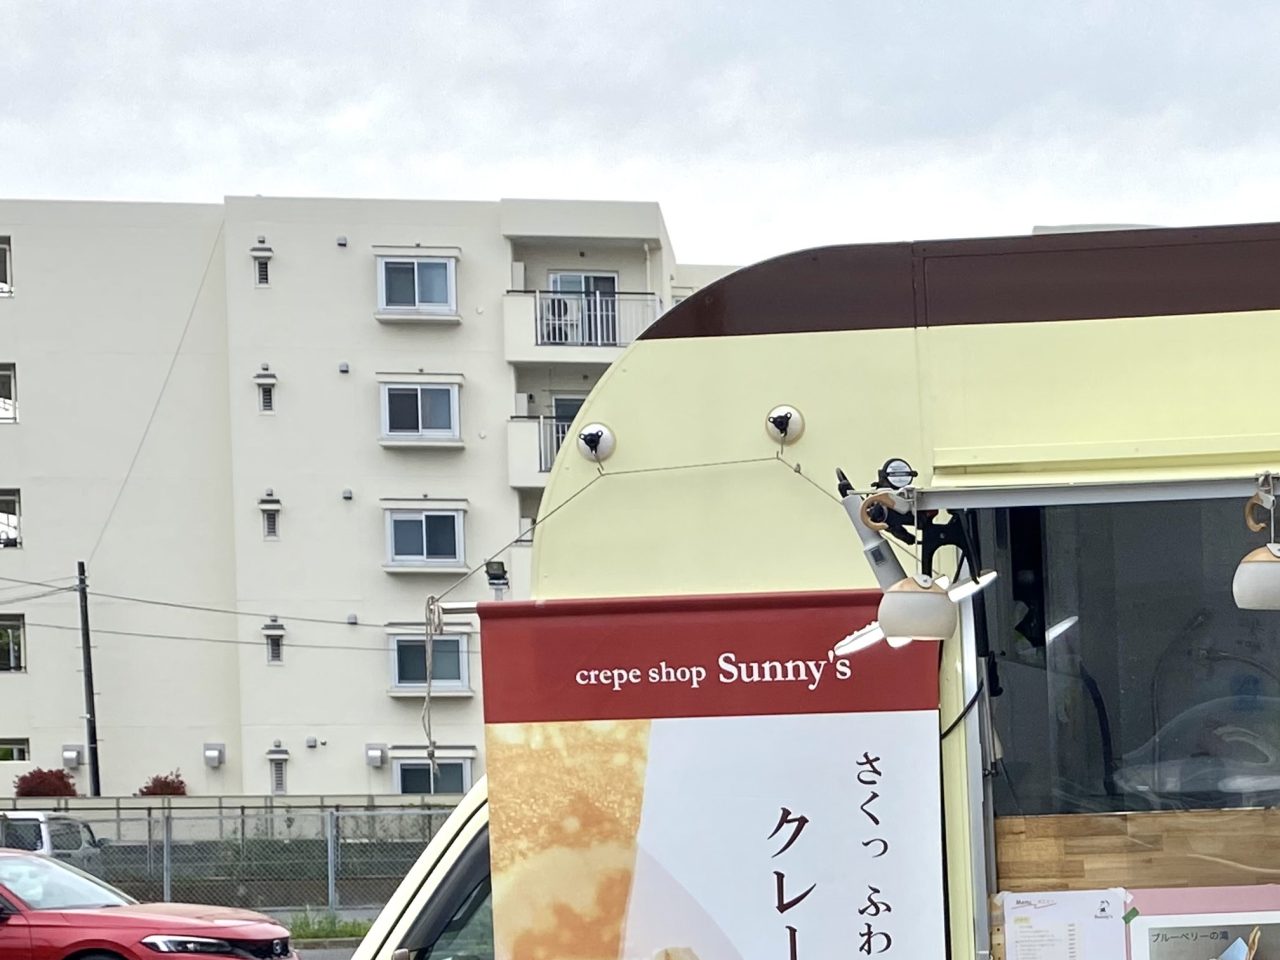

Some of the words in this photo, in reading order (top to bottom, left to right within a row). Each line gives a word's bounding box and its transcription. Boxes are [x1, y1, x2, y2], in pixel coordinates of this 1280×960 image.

[575, 665, 642, 691] crepe
[648, 661, 707, 690] shop
[717, 650, 852, 691] Sunny's
[855, 751, 889, 859] さくっ
